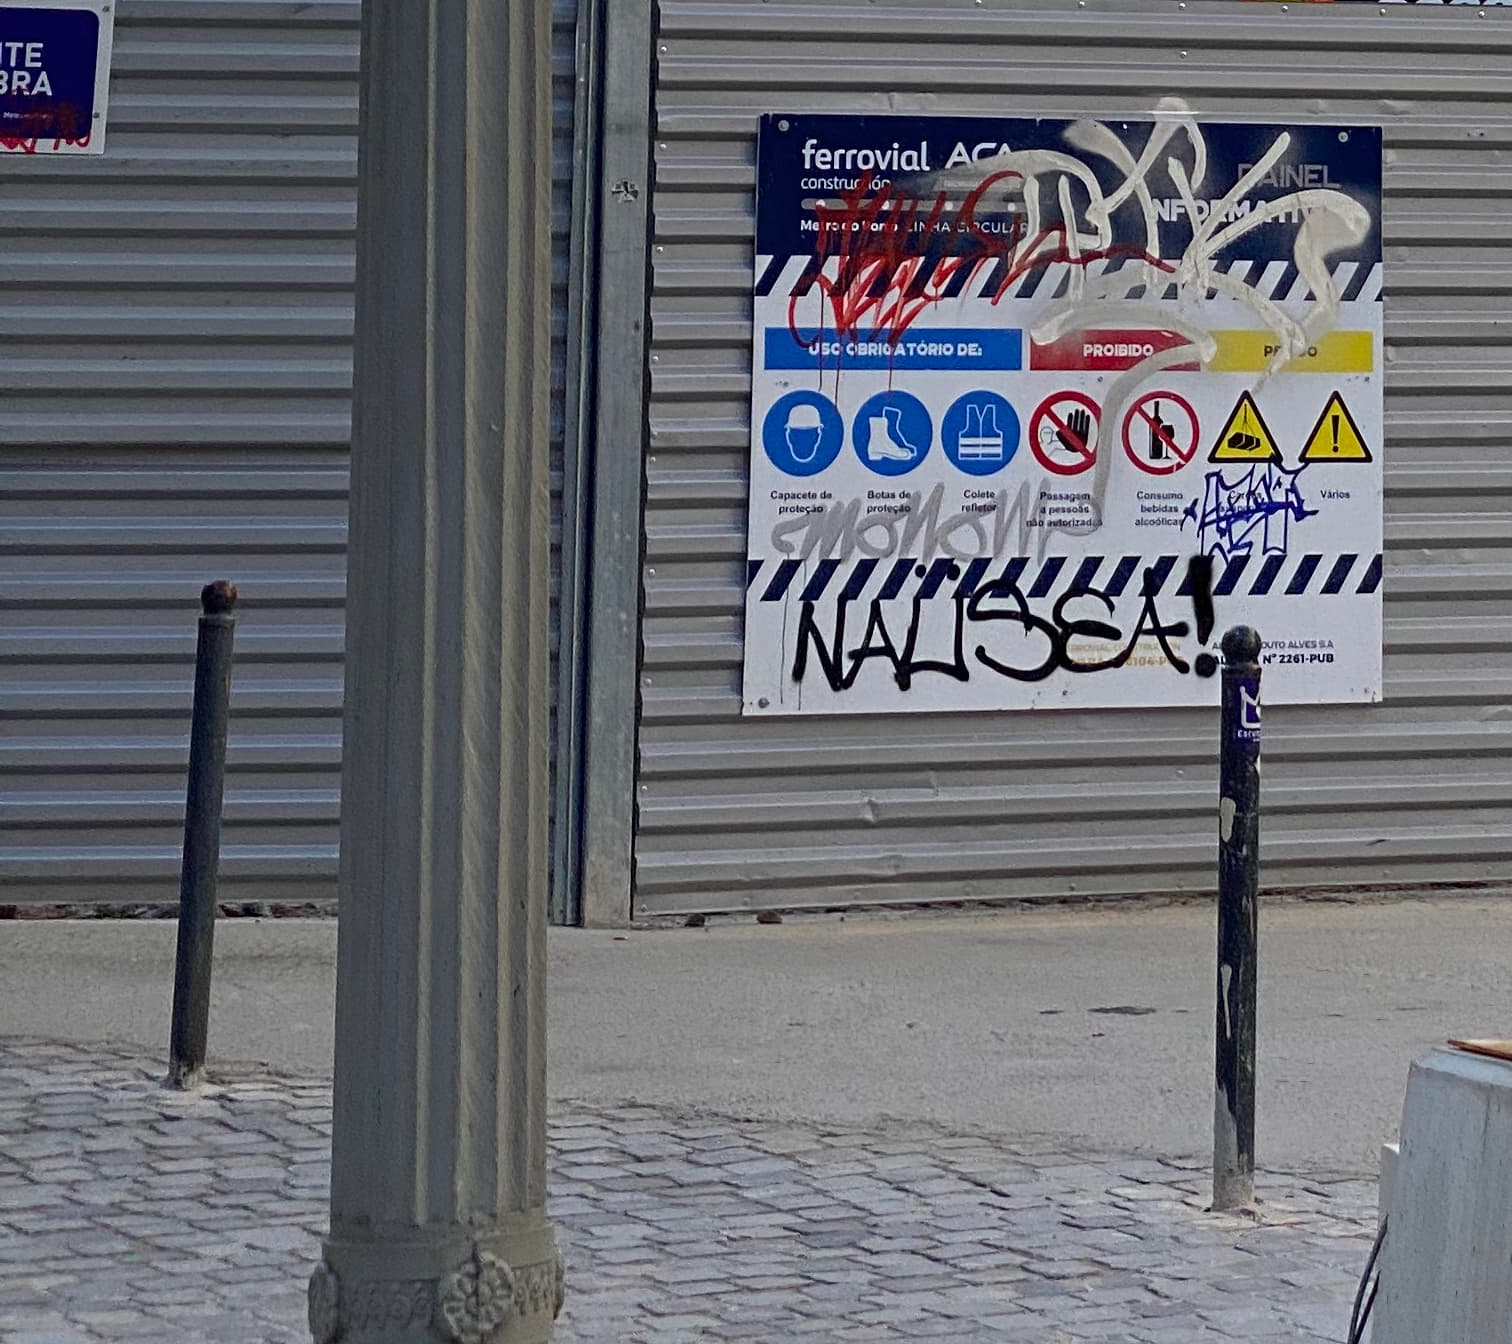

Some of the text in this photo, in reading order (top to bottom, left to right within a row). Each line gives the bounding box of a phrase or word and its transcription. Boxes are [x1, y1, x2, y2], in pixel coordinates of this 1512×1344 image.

[802, 138, 931, 172] ferrovial
[800, 219, 840, 232] Mero
[1082, 343, 1155, 359] PROIBIDO
[770, 490, 833, 501] Capacete de
[867, 490, 912, 500] Botas de
[963, 489, 996, 500] Colete
[1039, 491, 1091, 502] Passagem
[1136, 490, 1184, 501] Consumo
[1320, 489, 1351, 500] Vários
[778, 503, 824, 515] proteção
[866, 503, 912, 515] proteção
[1140, 503, 1179, 513] bebidas
[1287, 640, 1318, 649] ALVES
[1279, 653, 1335, 665] 2261-PUB
